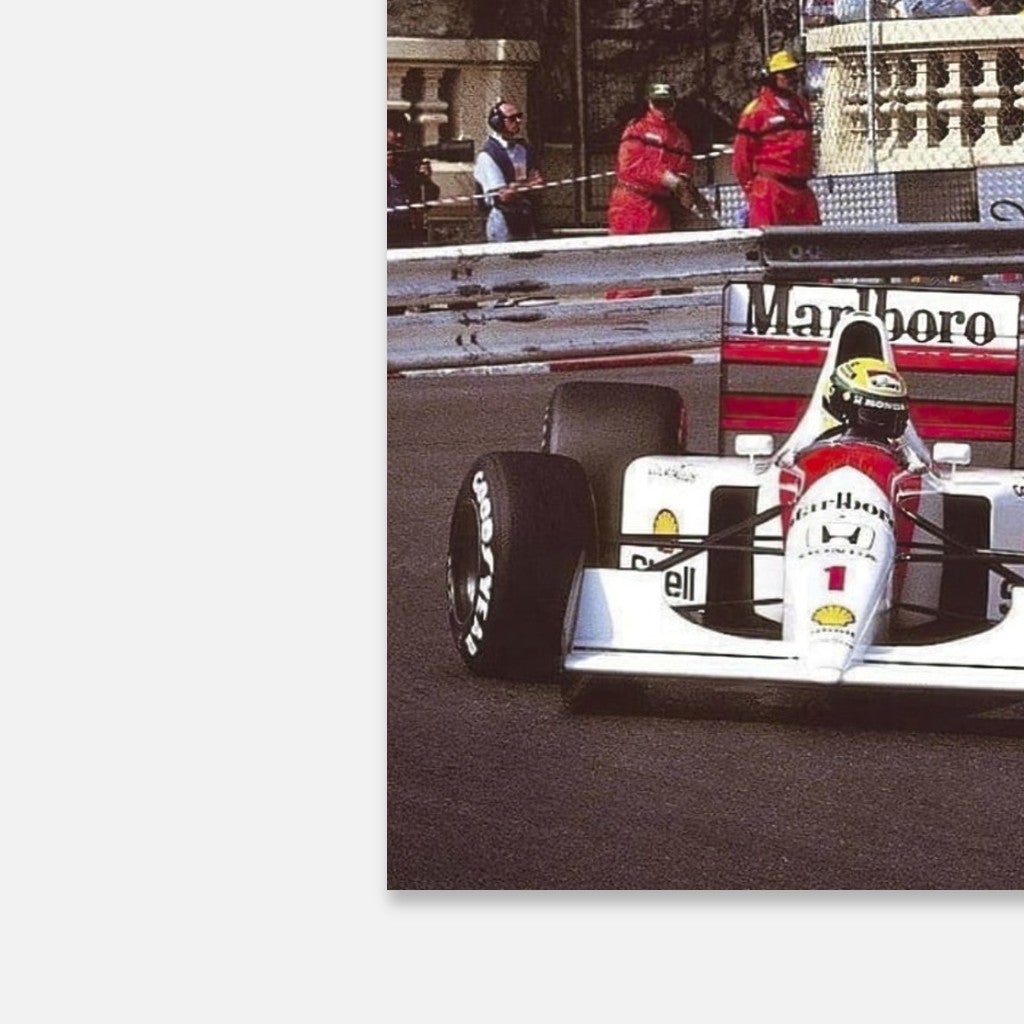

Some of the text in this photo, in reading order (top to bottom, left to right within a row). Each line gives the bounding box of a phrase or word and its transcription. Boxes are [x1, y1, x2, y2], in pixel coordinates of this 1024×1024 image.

[789, 491, 894, 528] arlbor
[631, 553, 696, 602] ell
[823, 565, 847, 591] 1
